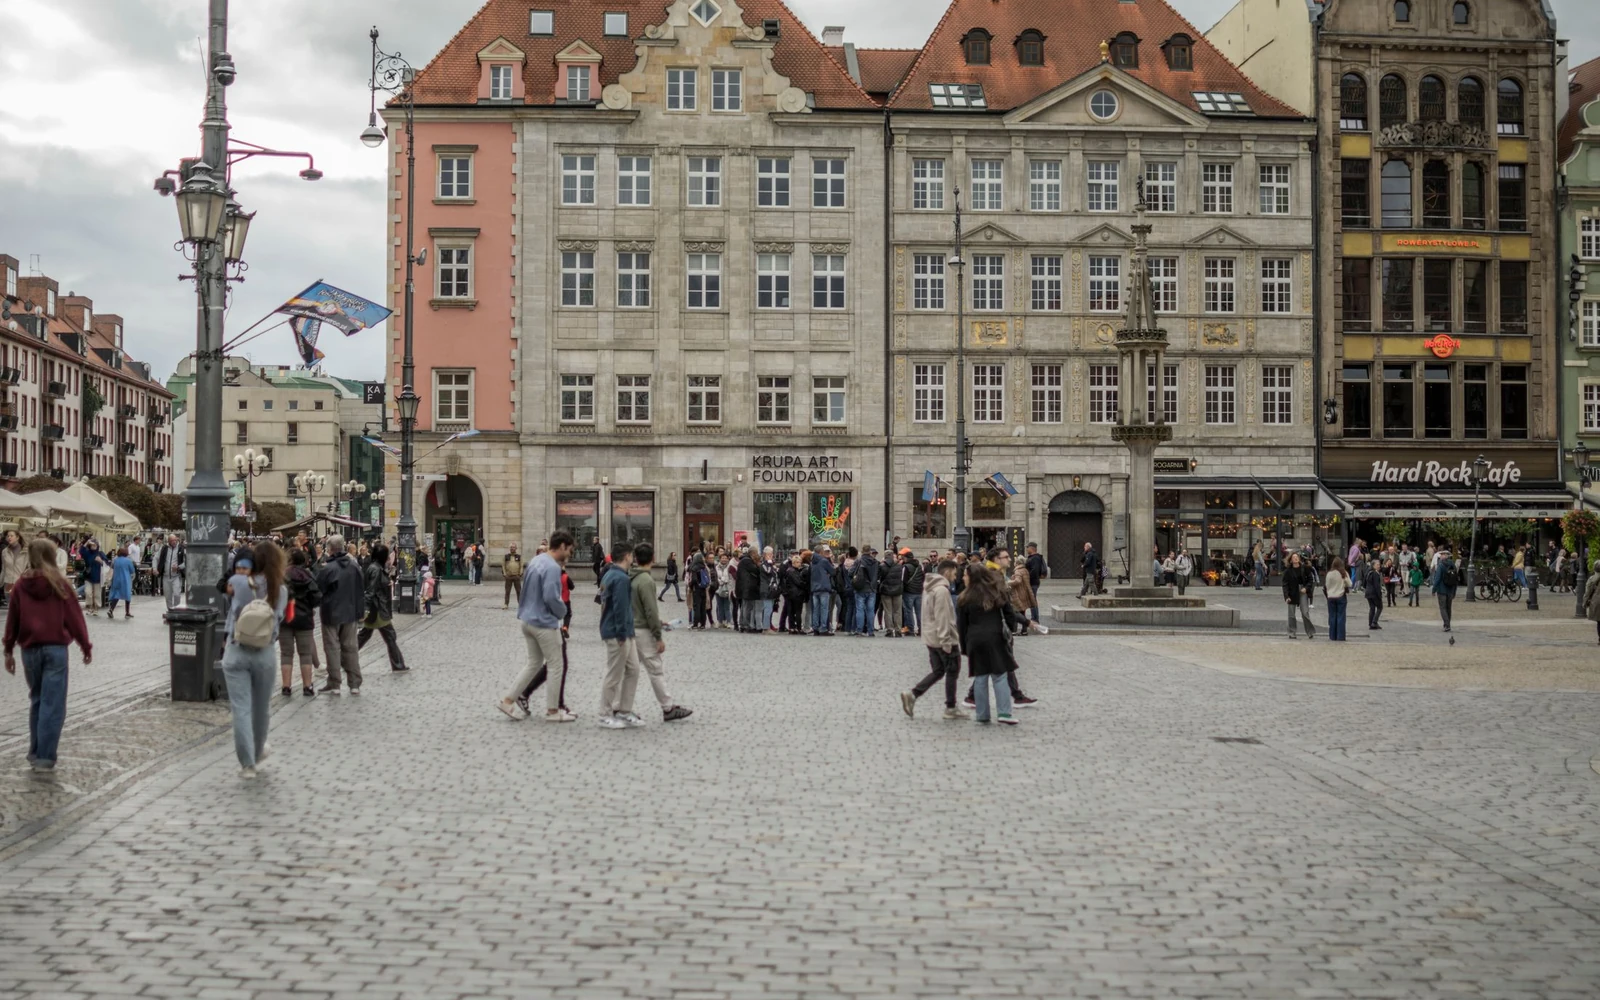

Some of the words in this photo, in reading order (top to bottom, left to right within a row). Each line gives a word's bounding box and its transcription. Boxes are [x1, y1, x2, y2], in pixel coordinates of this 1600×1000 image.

[1396, 239, 1479, 248] ROWERYSTYLOWE.PL
[367, 385, 381, 394] KA
[752, 456, 803, 468] KRUPA
[808, 456, 838, 468] ART
[753, 470, 853, 482] FOUNDATION
[1370, 460, 1423, 482] Hard
[1424, 460, 1472, 487] Rock
[760, 493, 793, 503] LIBERA
[980, 496, 997, 508] 26
